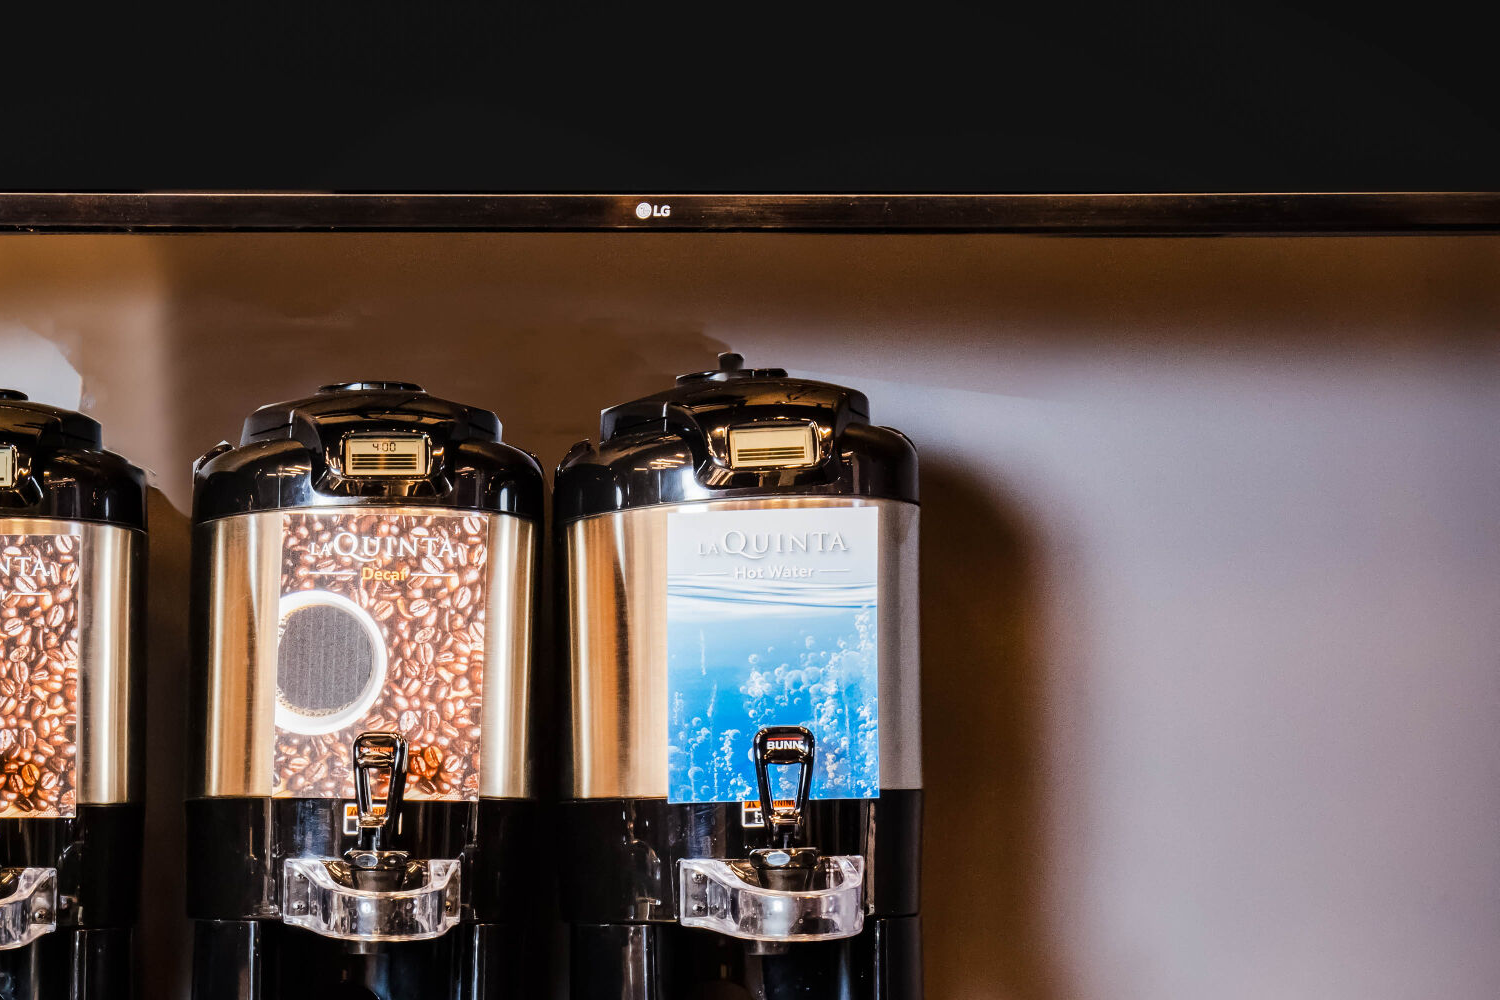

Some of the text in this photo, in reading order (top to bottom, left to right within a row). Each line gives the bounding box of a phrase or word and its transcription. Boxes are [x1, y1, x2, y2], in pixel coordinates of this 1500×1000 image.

[653, 204, 671, 217] LG
[372, 441, 397, 452] 4:00
[310, 531, 457, 563] LA QUINTA
[698, 529, 850, 560] LA QUINTA
[362, 566, 407, 581] Decaf
[734, 565, 814, 580] Hot Water
[766, 740, 804, 750] BUNN
